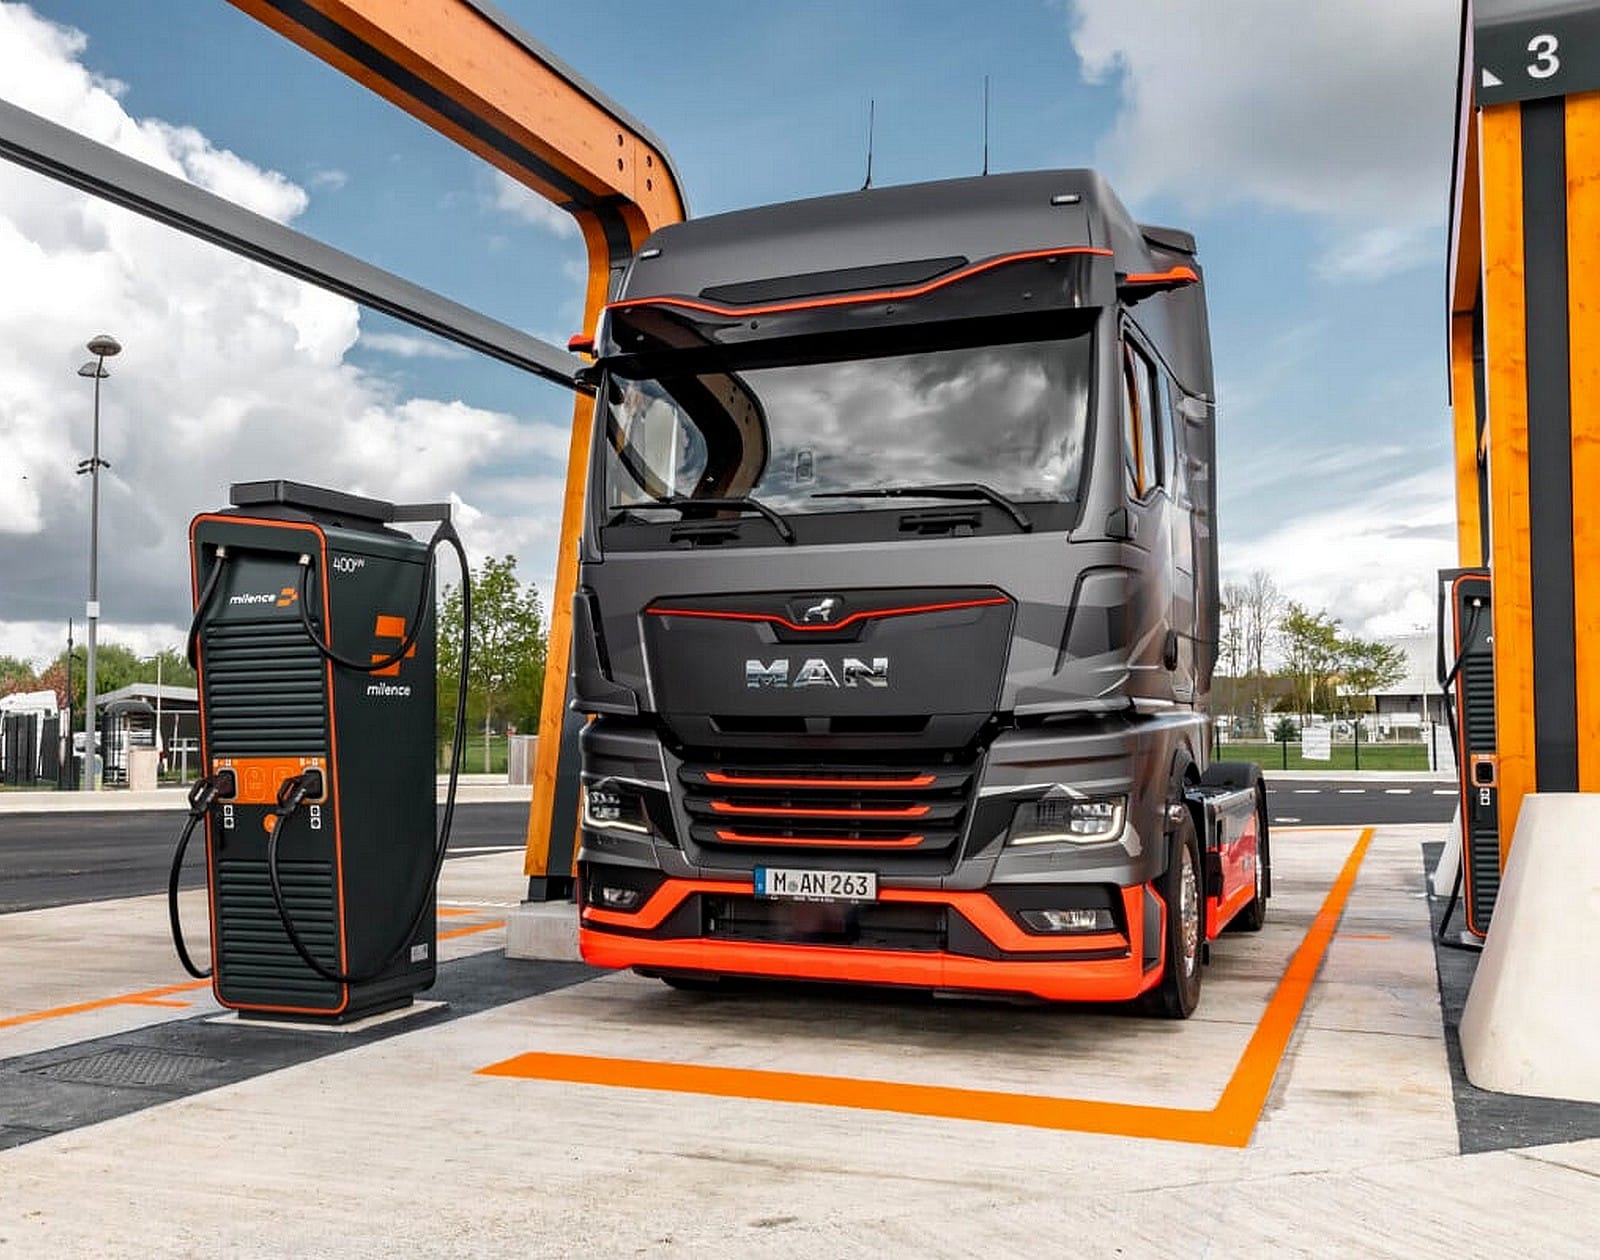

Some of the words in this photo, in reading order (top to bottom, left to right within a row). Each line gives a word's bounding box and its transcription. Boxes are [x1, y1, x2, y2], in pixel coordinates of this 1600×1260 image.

[1527, 34, 1560, 79] 3
[230, 593, 276, 605] milence
[746, 657, 888, 688] MAN
[367, 681, 411, 696] milence
[774, 872, 786, 892] M
[800, 873, 826, 894] AN
[830, 875, 868, 896] 263
